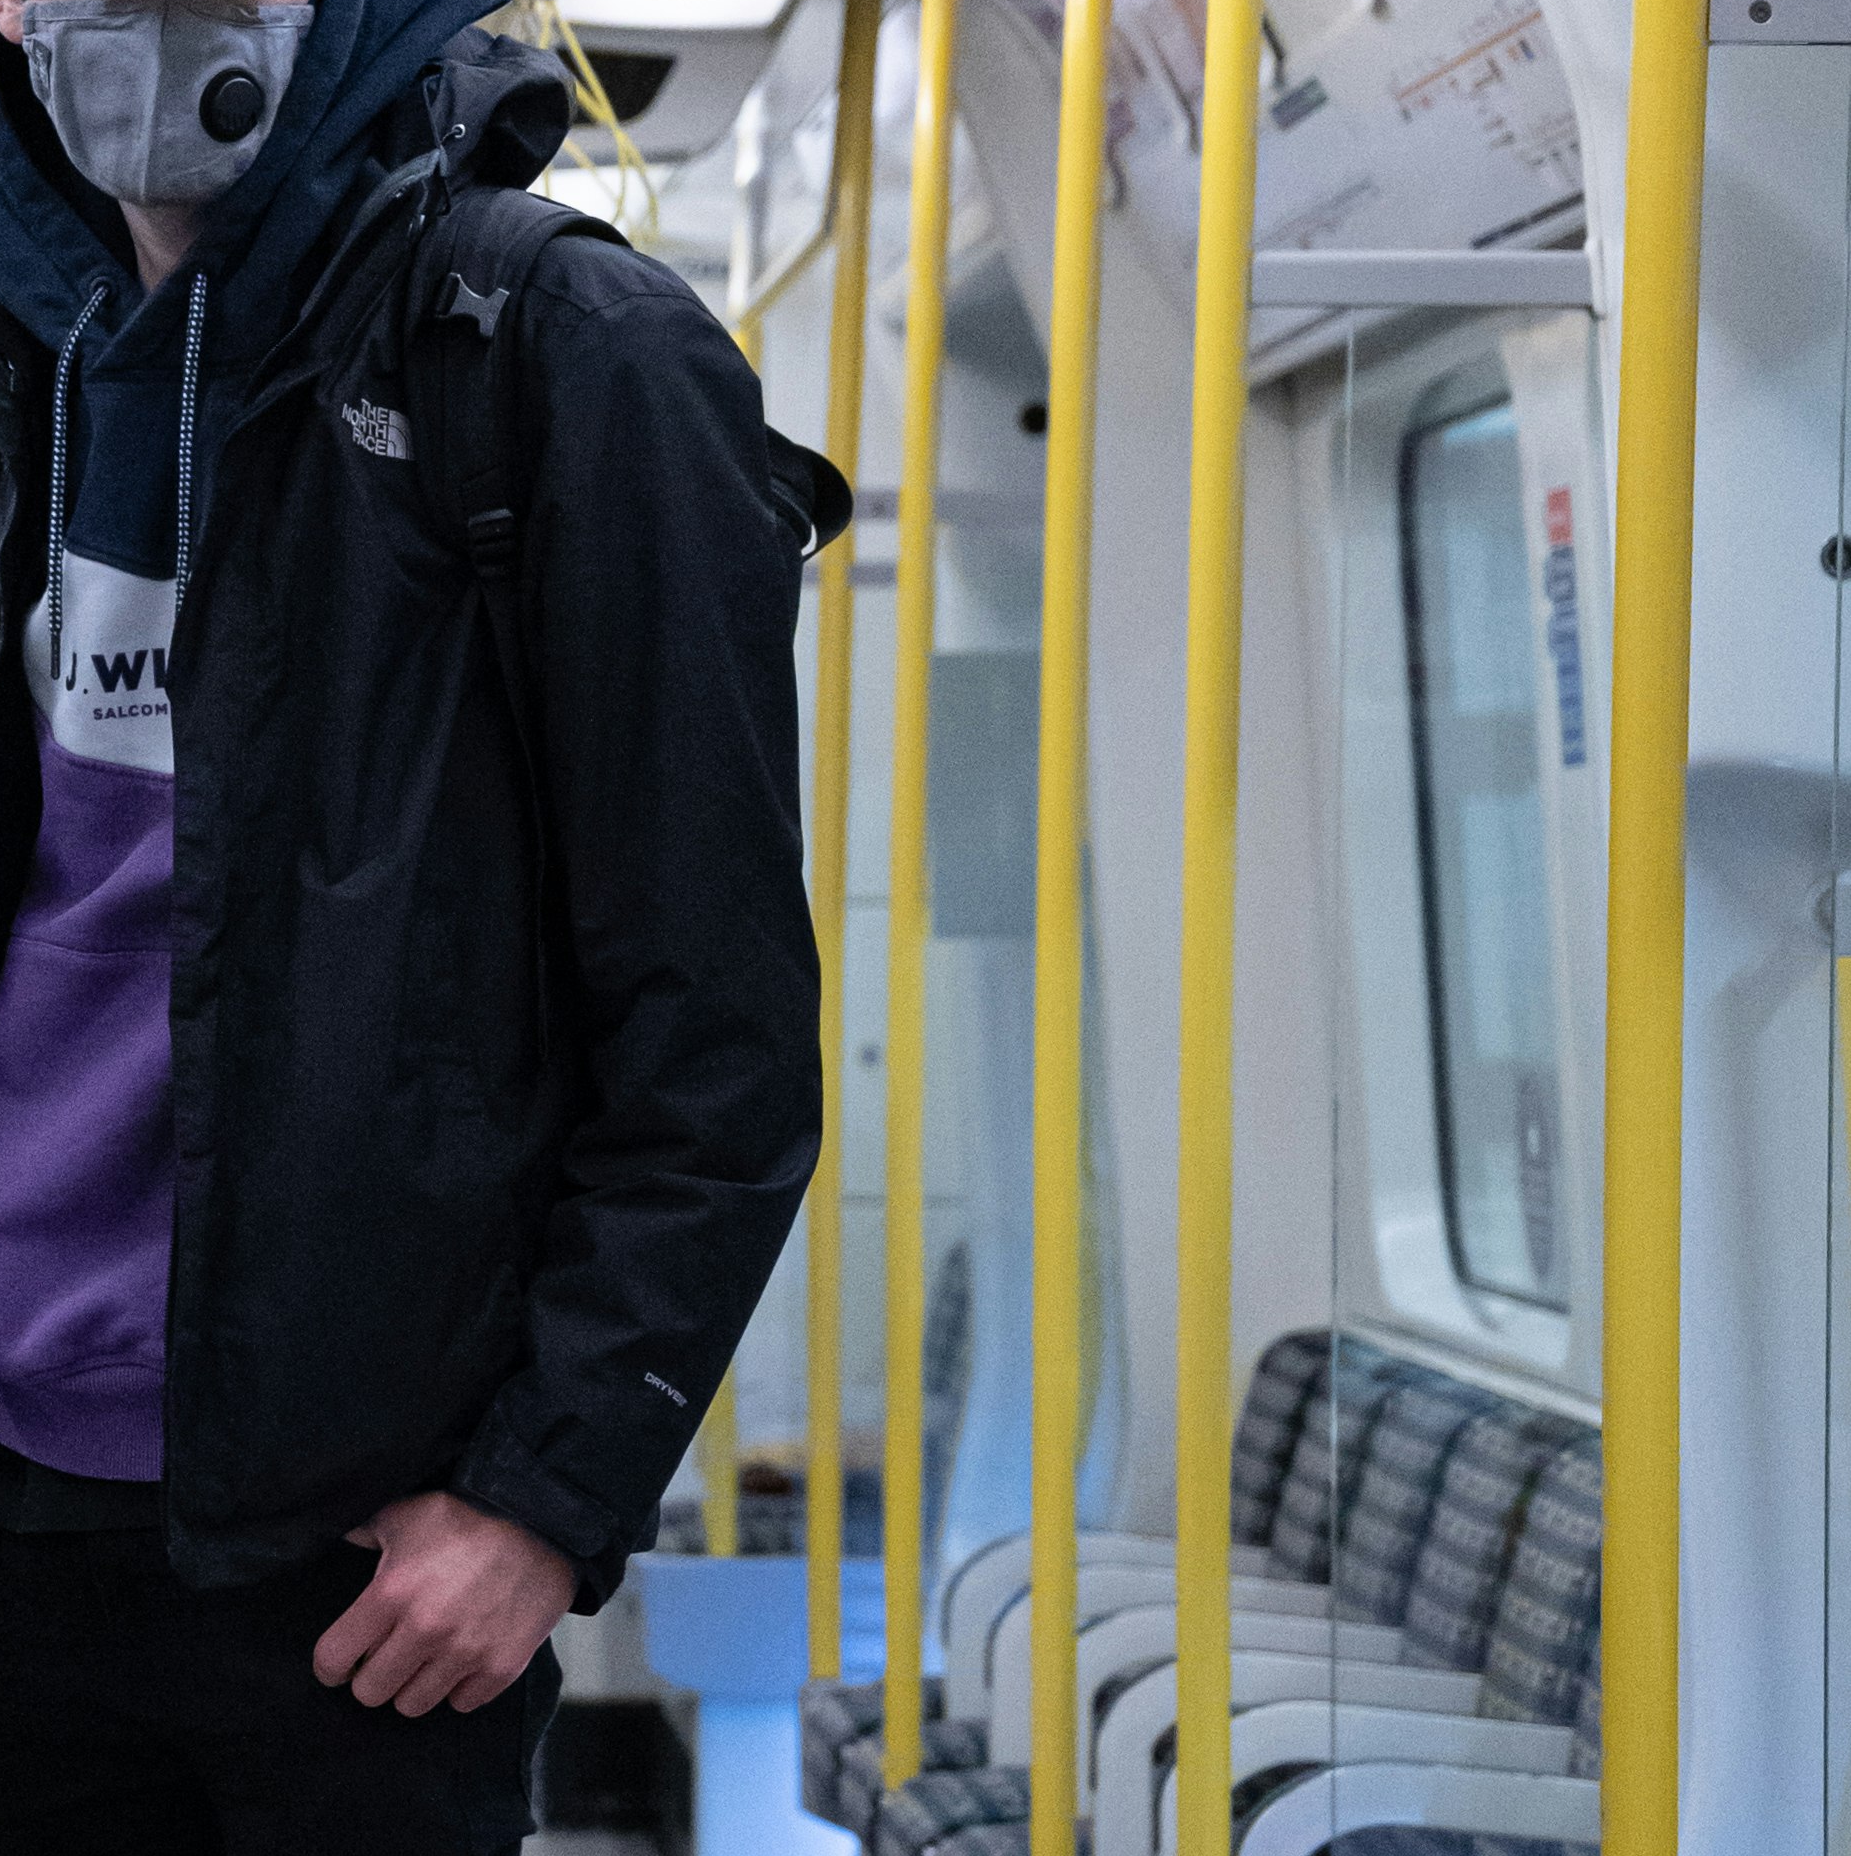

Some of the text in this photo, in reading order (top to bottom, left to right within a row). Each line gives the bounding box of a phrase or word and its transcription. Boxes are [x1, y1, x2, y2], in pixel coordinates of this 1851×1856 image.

[341, 403, 387, 440] NORTH
[361, 398, 388, 425] THE
[352, 426, 387, 456] FACE
